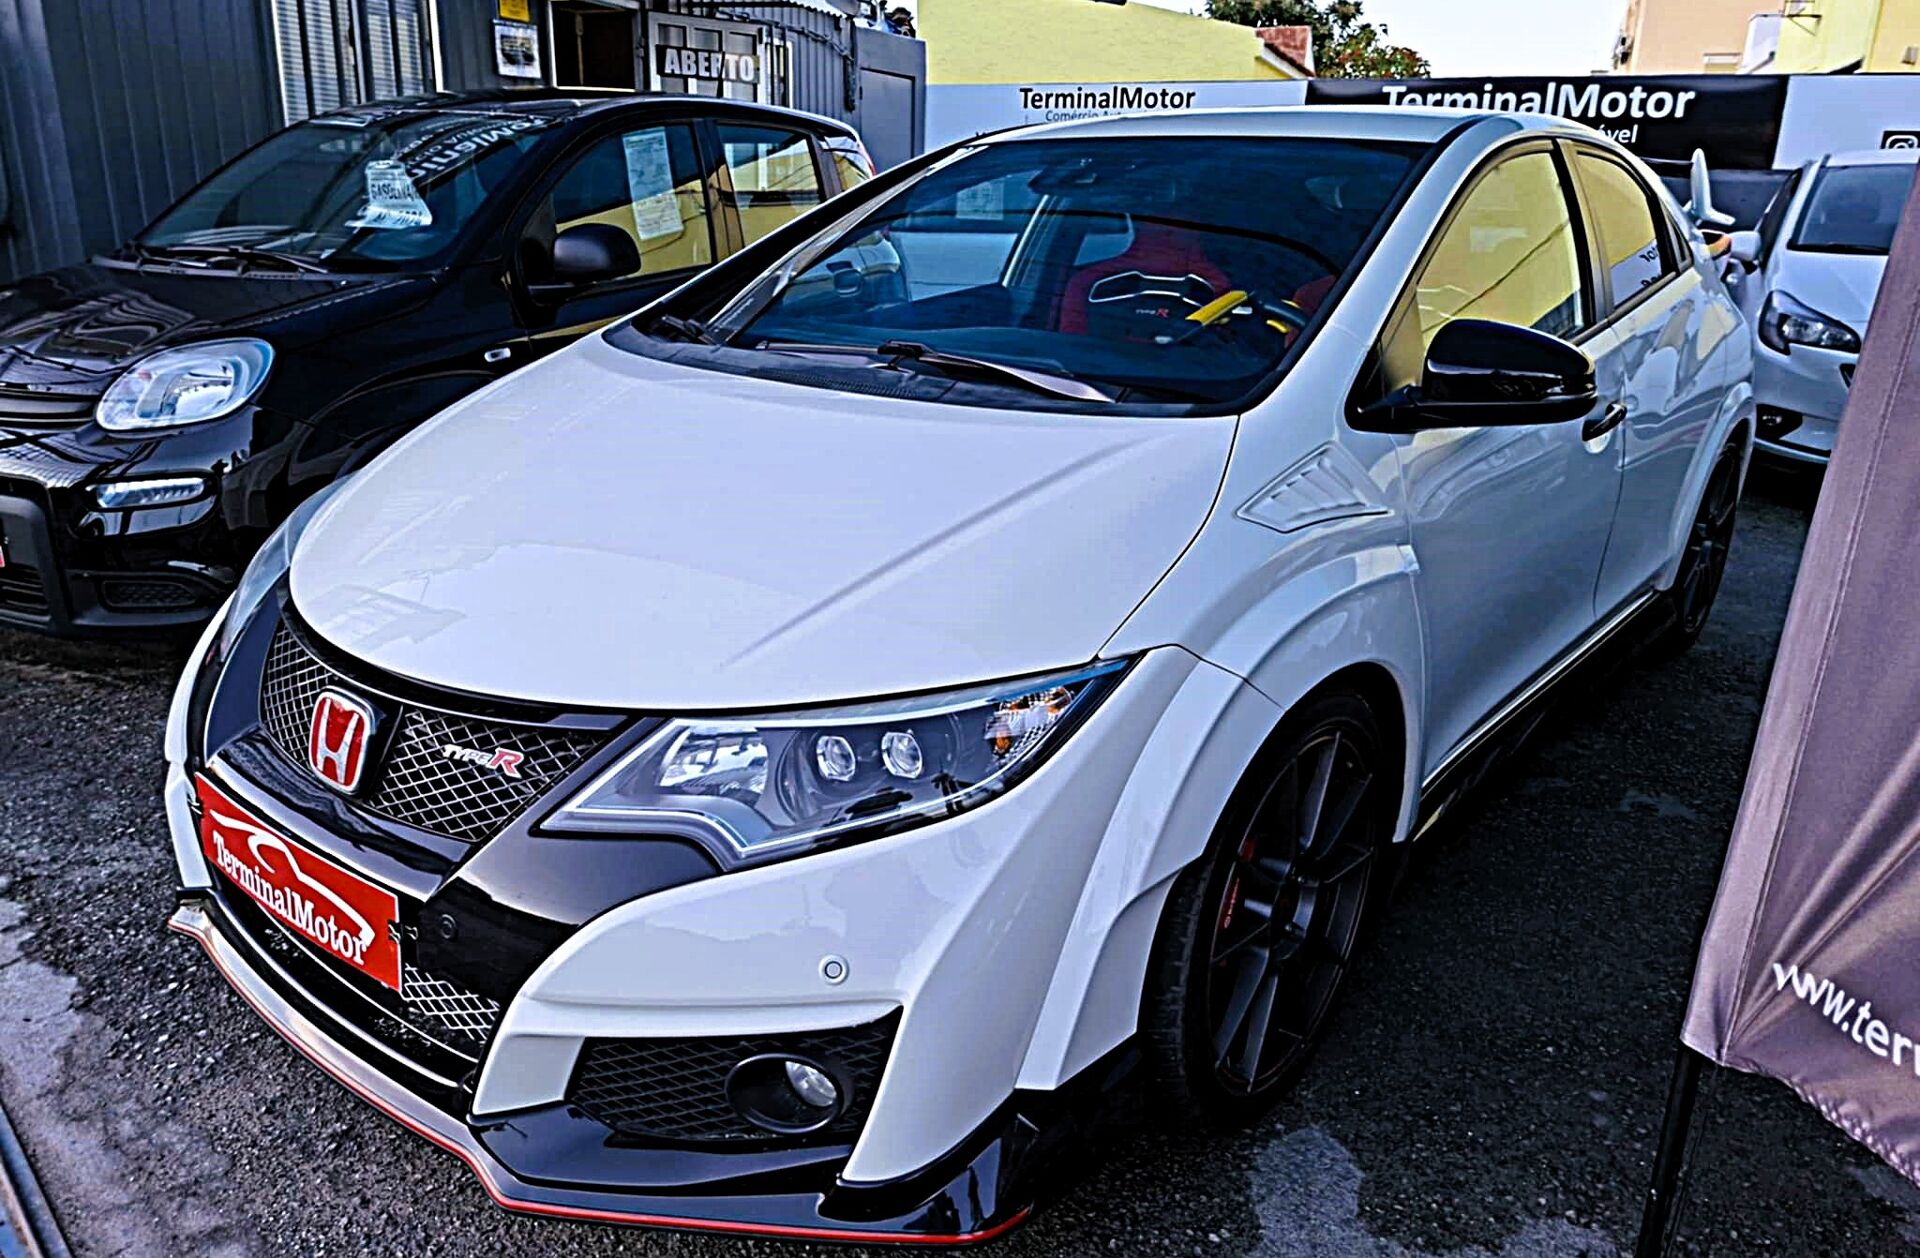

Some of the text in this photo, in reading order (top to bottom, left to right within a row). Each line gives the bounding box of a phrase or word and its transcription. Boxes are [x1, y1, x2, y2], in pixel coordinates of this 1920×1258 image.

[664, 48, 754, 81] ABERTO
[1019, 86, 1196, 109] TerminalMotor
[1382, 82, 1696, 118] TerminalMotor
[212, 829, 367, 966] TerminalMotor
[1773, 963, 1920, 1077] www.ter
